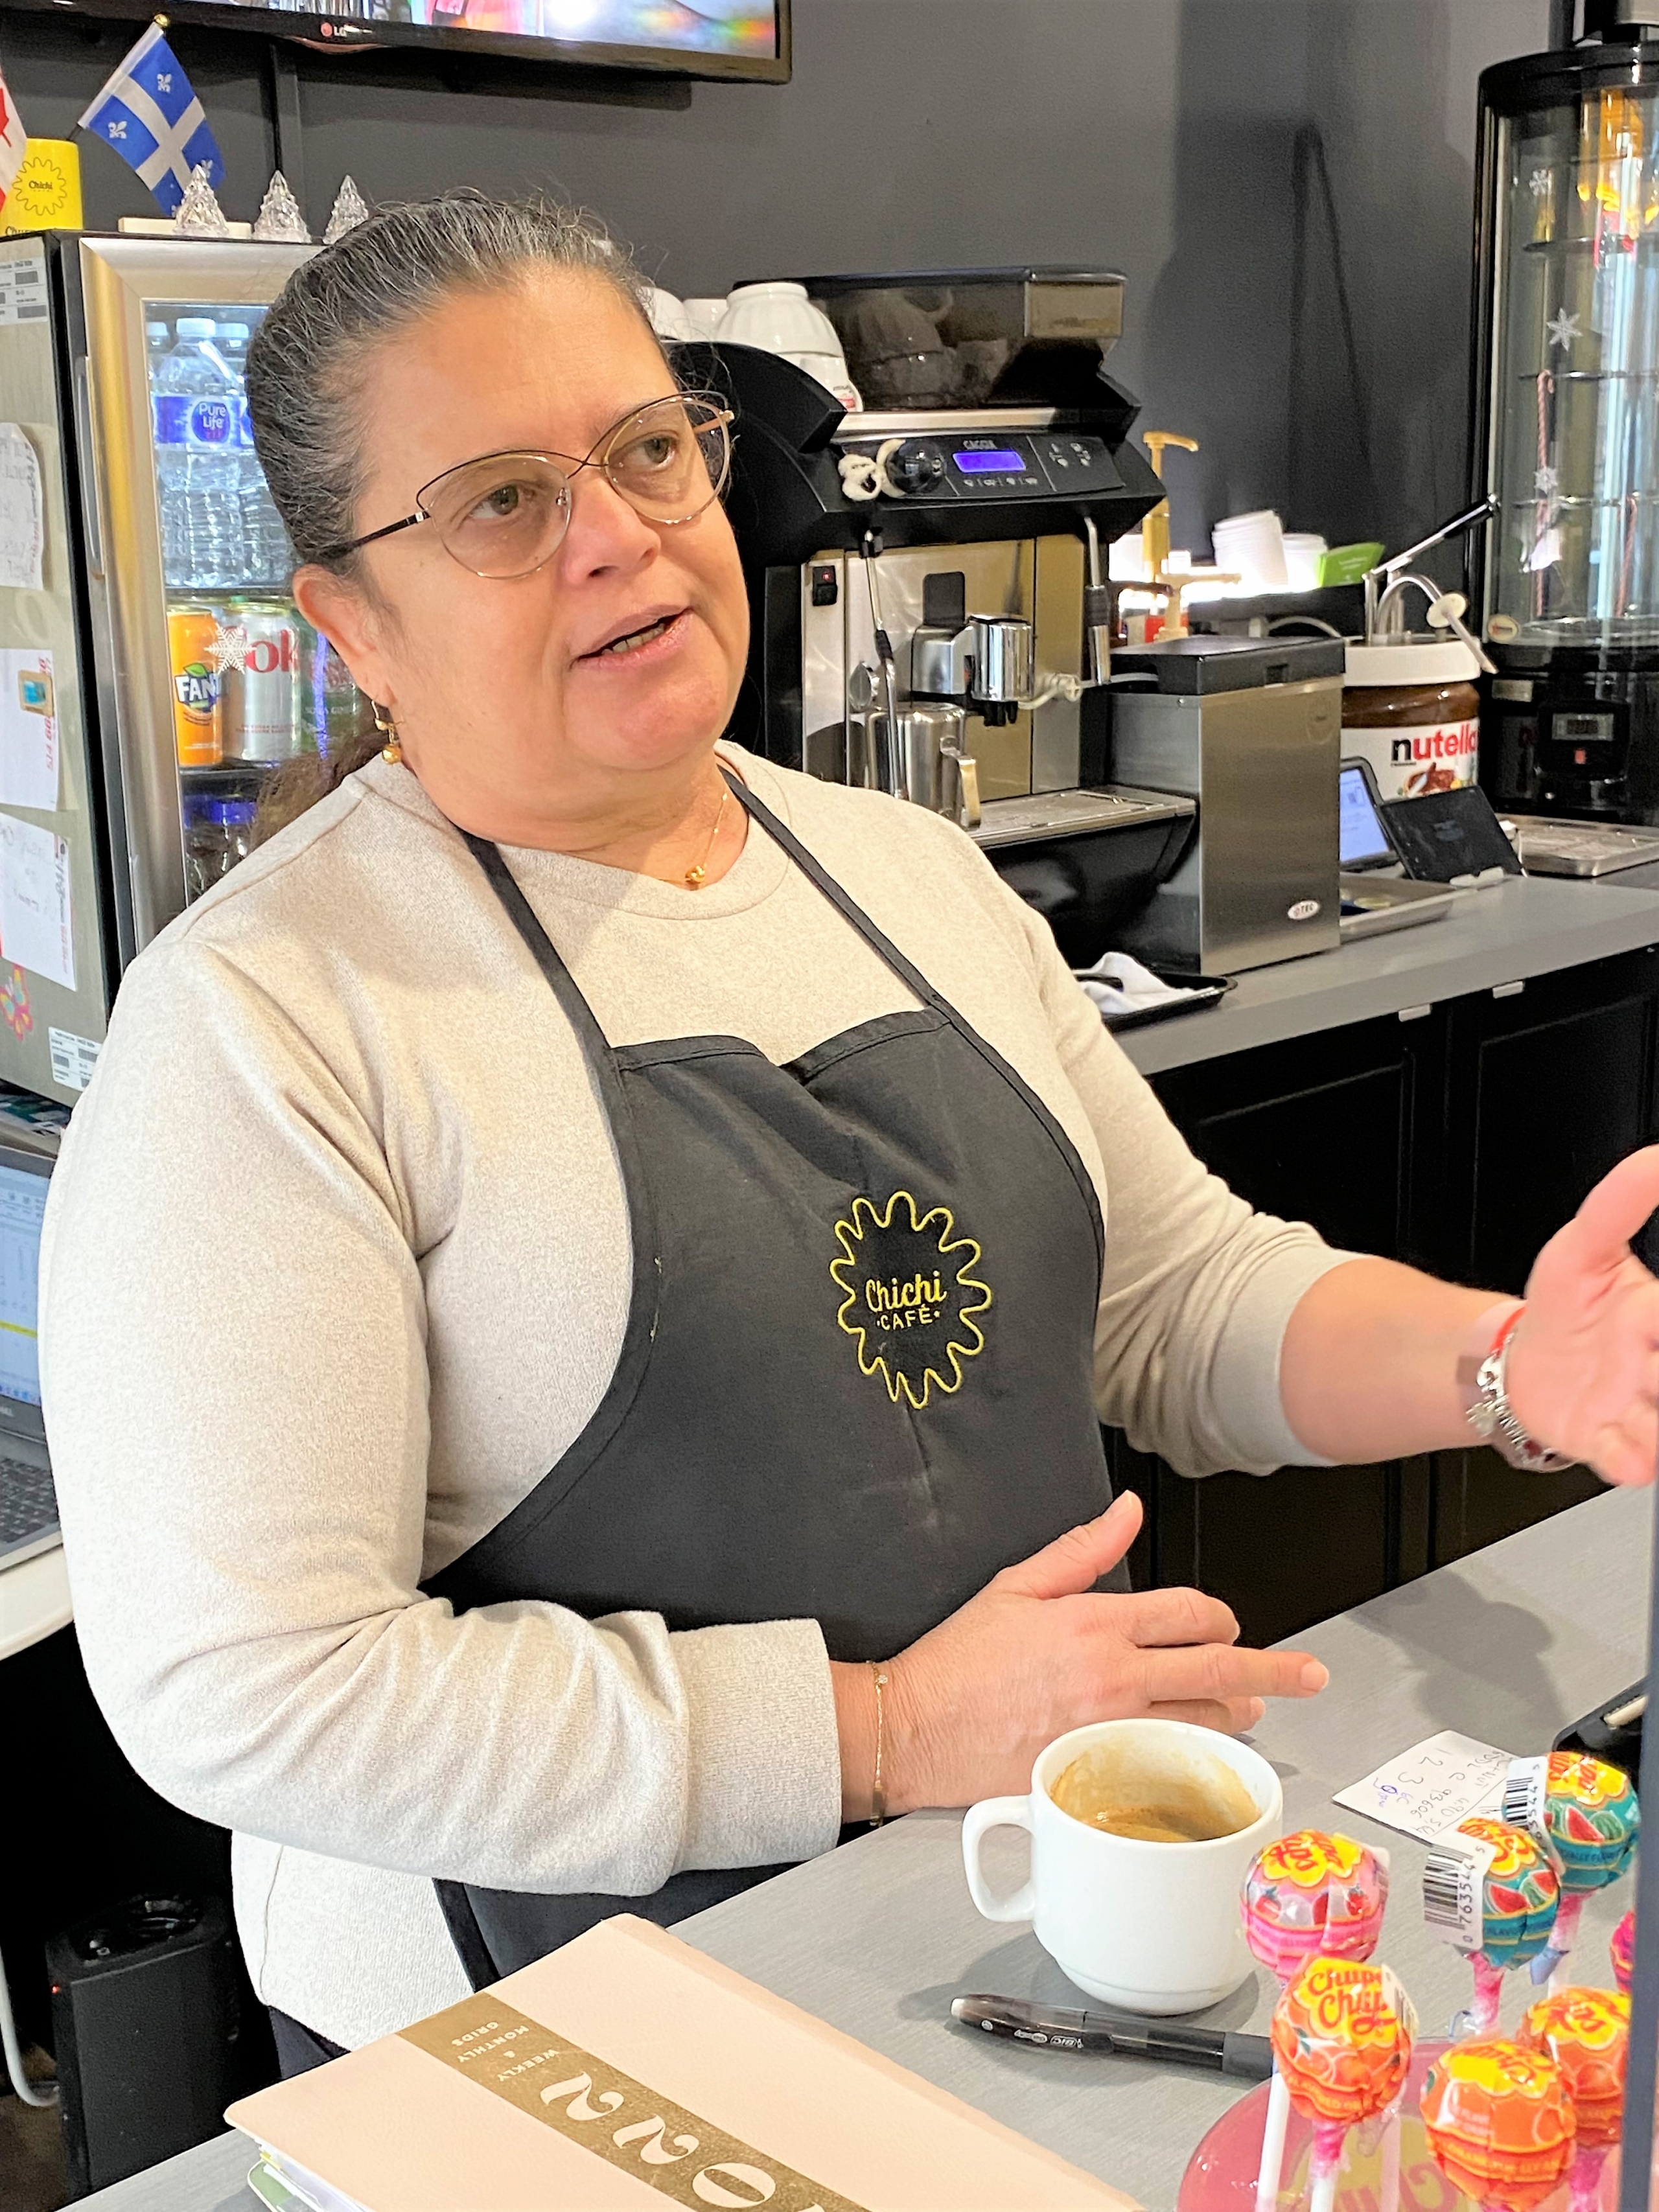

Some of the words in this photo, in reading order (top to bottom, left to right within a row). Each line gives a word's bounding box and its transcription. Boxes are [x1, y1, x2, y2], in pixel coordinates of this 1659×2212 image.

[199, 402, 226, 417] Pure
[203, 415, 224, 430] Life
[866, 1269, 948, 1312] Chichi
[451, 2022, 499, 2047] GRIDS
[457, 2025, 530, 2063] MONTHLY
[496, 2048, 560, 2082] WEEKLY
[502, 2050, 516, 2058] &
[539, 2070, 826, 2212] 022
